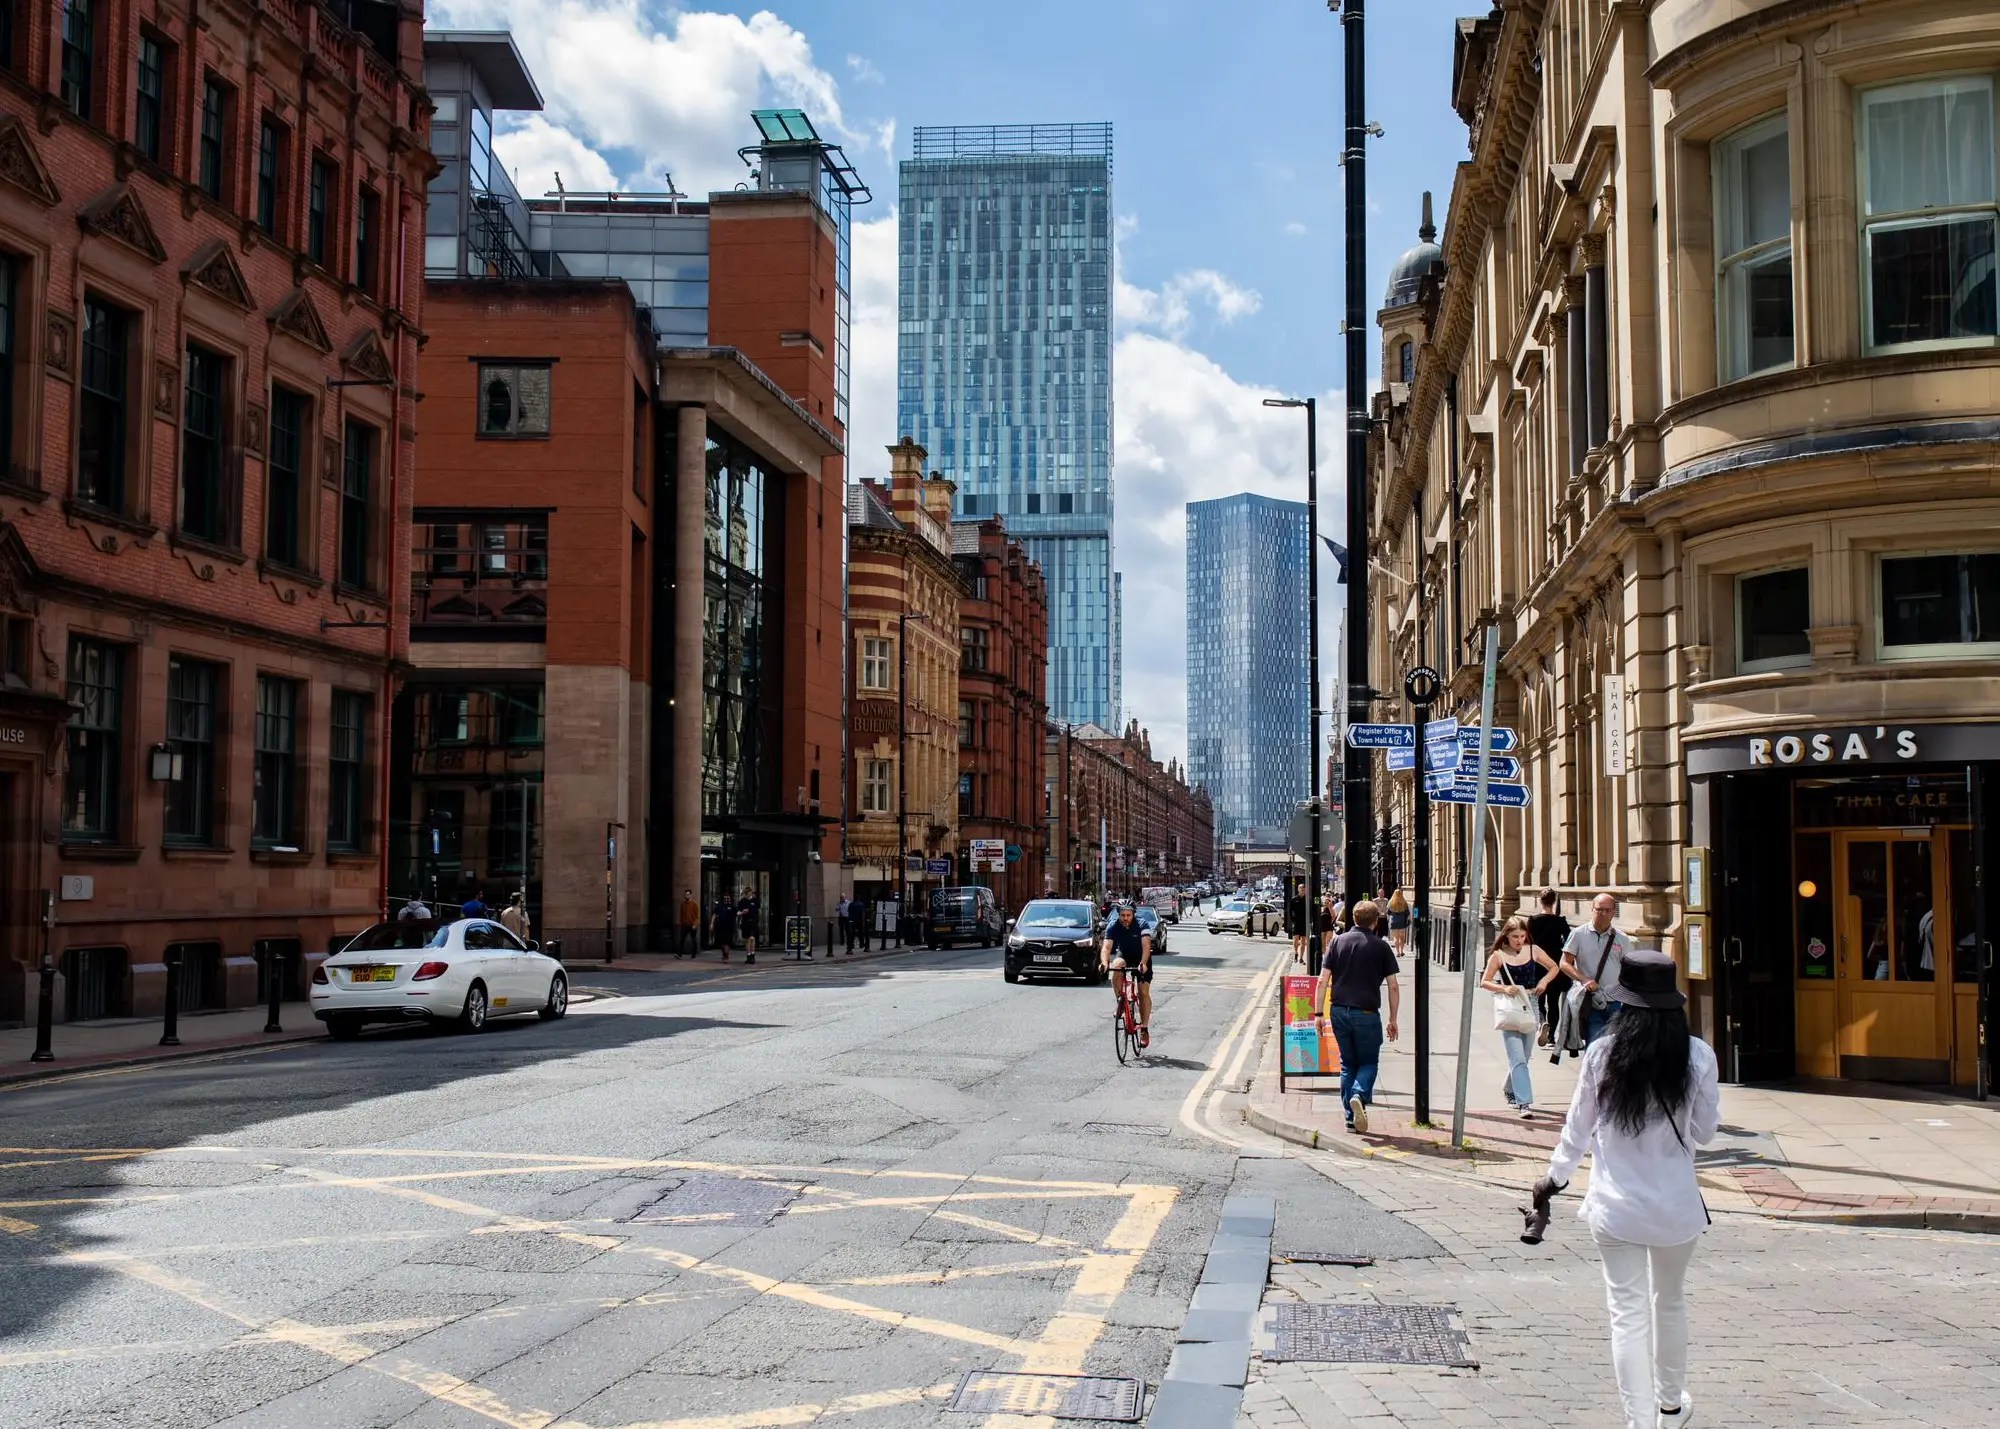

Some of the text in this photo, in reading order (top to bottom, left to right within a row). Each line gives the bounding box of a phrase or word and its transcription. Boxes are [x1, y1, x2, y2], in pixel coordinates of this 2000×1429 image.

[1406, 668, 1438, 684] Deansgate
[1357, 727, 1403, 735] Register Office
[1610, 681, 1619, 768] THAI CAFE
[0, 727, 24, 742] use
[1357, 736, 1373, 744] Town
[1374, 736, 1387, 744] Hall
[1459, 730, 1479, 738] Opera
[1750, 726, 1918, 766] ROSA'S
[1497, 794, 1520, 803] Square
[1834, 792, 1948, 808] THAI CAFE
